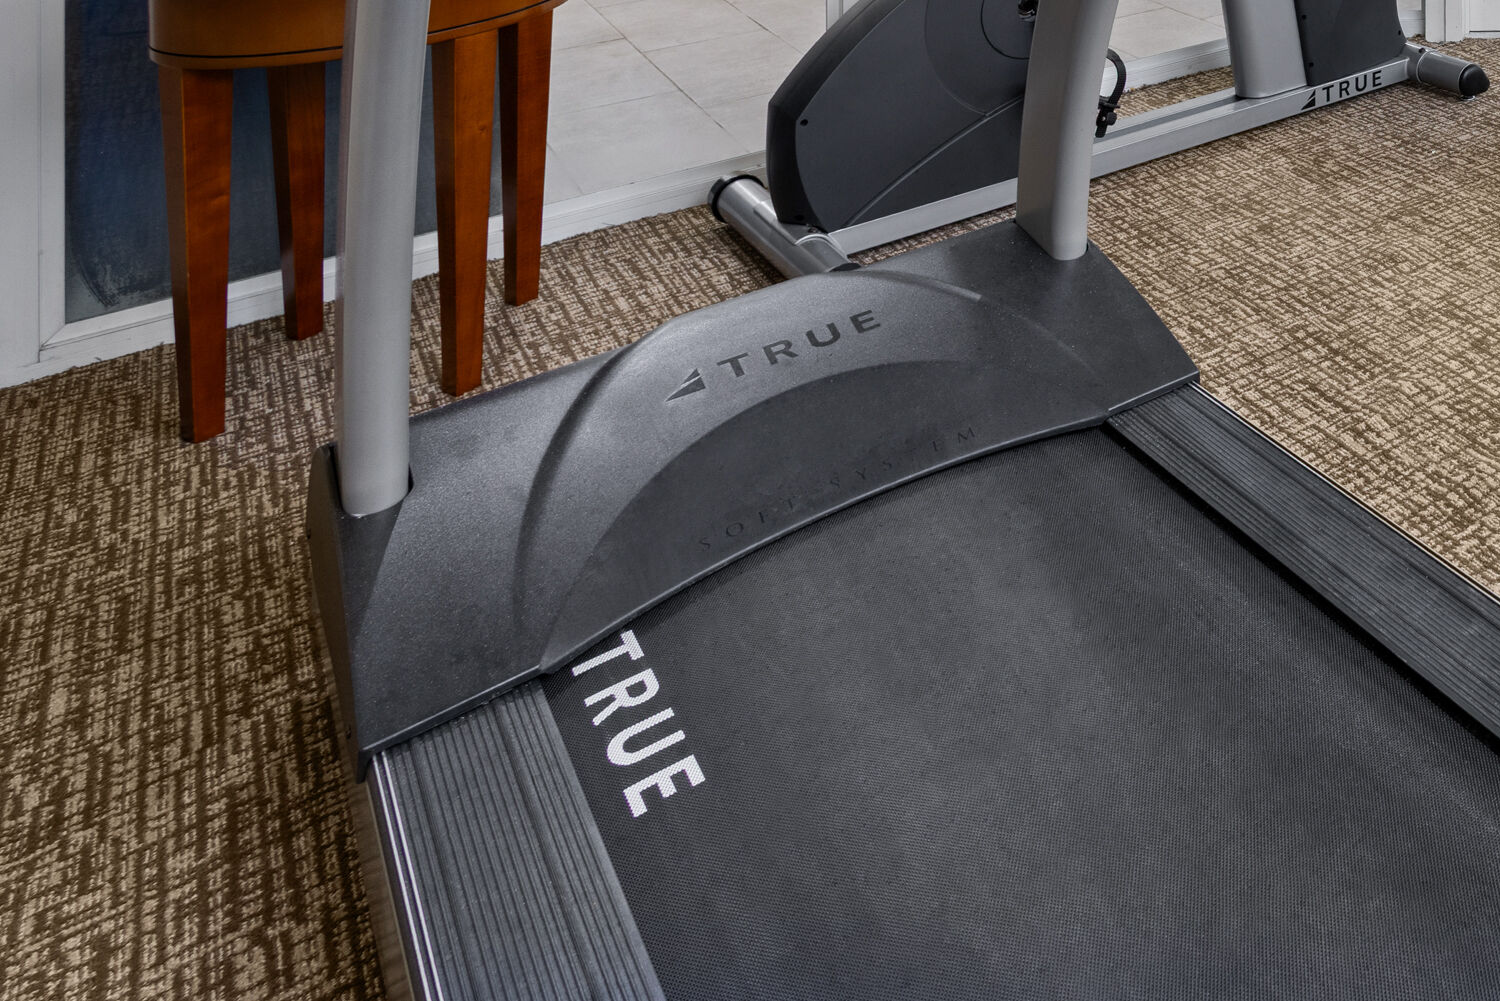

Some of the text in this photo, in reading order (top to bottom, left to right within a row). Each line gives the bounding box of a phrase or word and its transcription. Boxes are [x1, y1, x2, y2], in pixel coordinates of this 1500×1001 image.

[1322, 69, 1382, 102] TRUE
[717, 309, 882, 378] TRUE
[571, 629, 706, 818] TRUE
